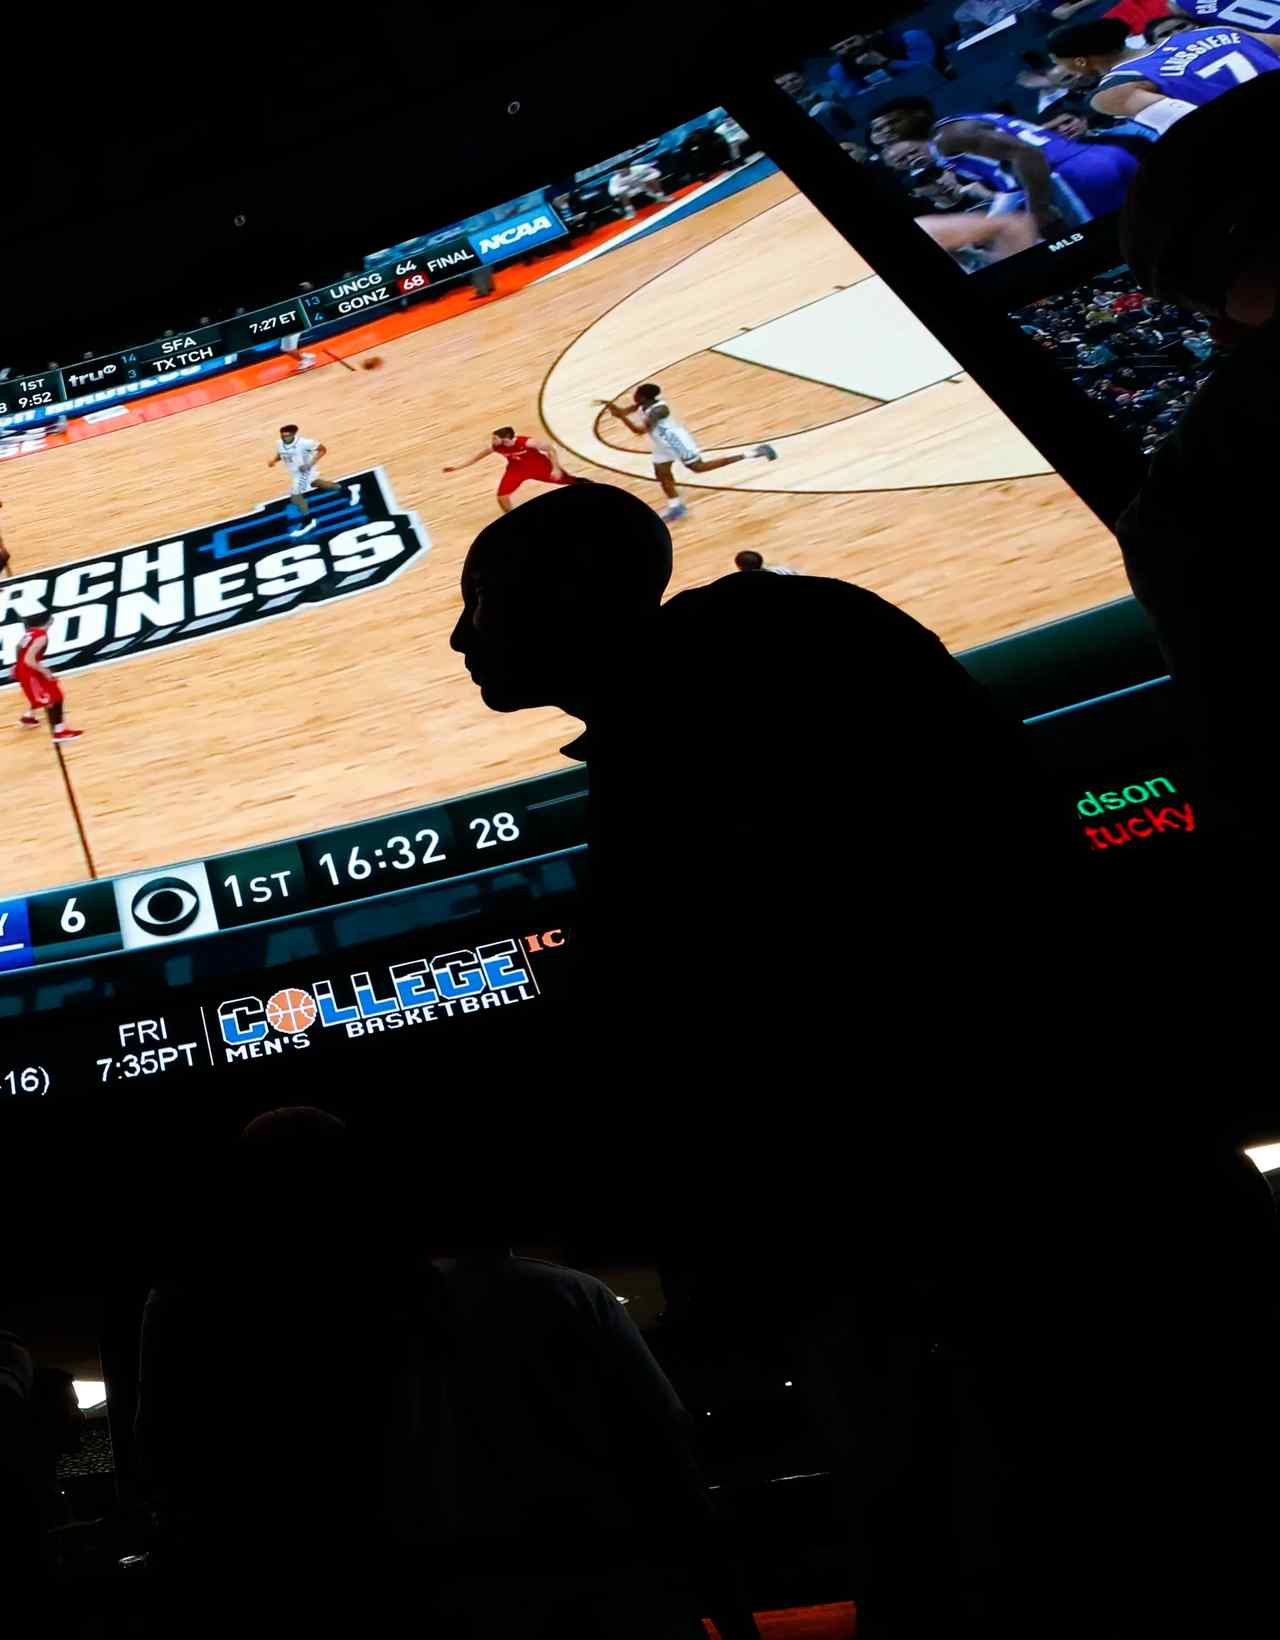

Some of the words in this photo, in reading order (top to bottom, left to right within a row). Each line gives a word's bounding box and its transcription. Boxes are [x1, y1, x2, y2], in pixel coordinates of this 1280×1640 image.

[1194, 50, 1259, 84] 7
[479, 215, 552, 255] NCAA
[1048, 233, 1084, 252] MLB
[304, 294, 321, 307] 13
[329, 272, 383, 299] UNCG
[396, 260, 417, 276] 64
[427, 248, 475, 273] FINAL
[338, 287, 391, 315] GONZ
[402, 274, 426, 290] 68
[249, 315, 277, 334] 7:27
[278, 309, 297, 327] ET
[161, 336, 198, 354] SFA
[128, 368, 137, 379] 3
[153, 358, 176, 372] TX
[177, 346, 213, 366] TCH
[18, 391, 53, 409] 9:52
[20, 378, 45, 393] 1ST
[224, 869, 292, 908] 1ST
[318, 828, 447, 887] 16:32
[468, 811, 521, 851] 28
[59, 897, 87, 934] 6
[526, 927, 566, 954] IC
[119, 1016, 169, 1049] FRI
[225, 1033, 311, 1064] MEN'S
[345, 987, 535, 1040] BASKETBALL
[96, 1042, 198, 1083] 7:35PT
